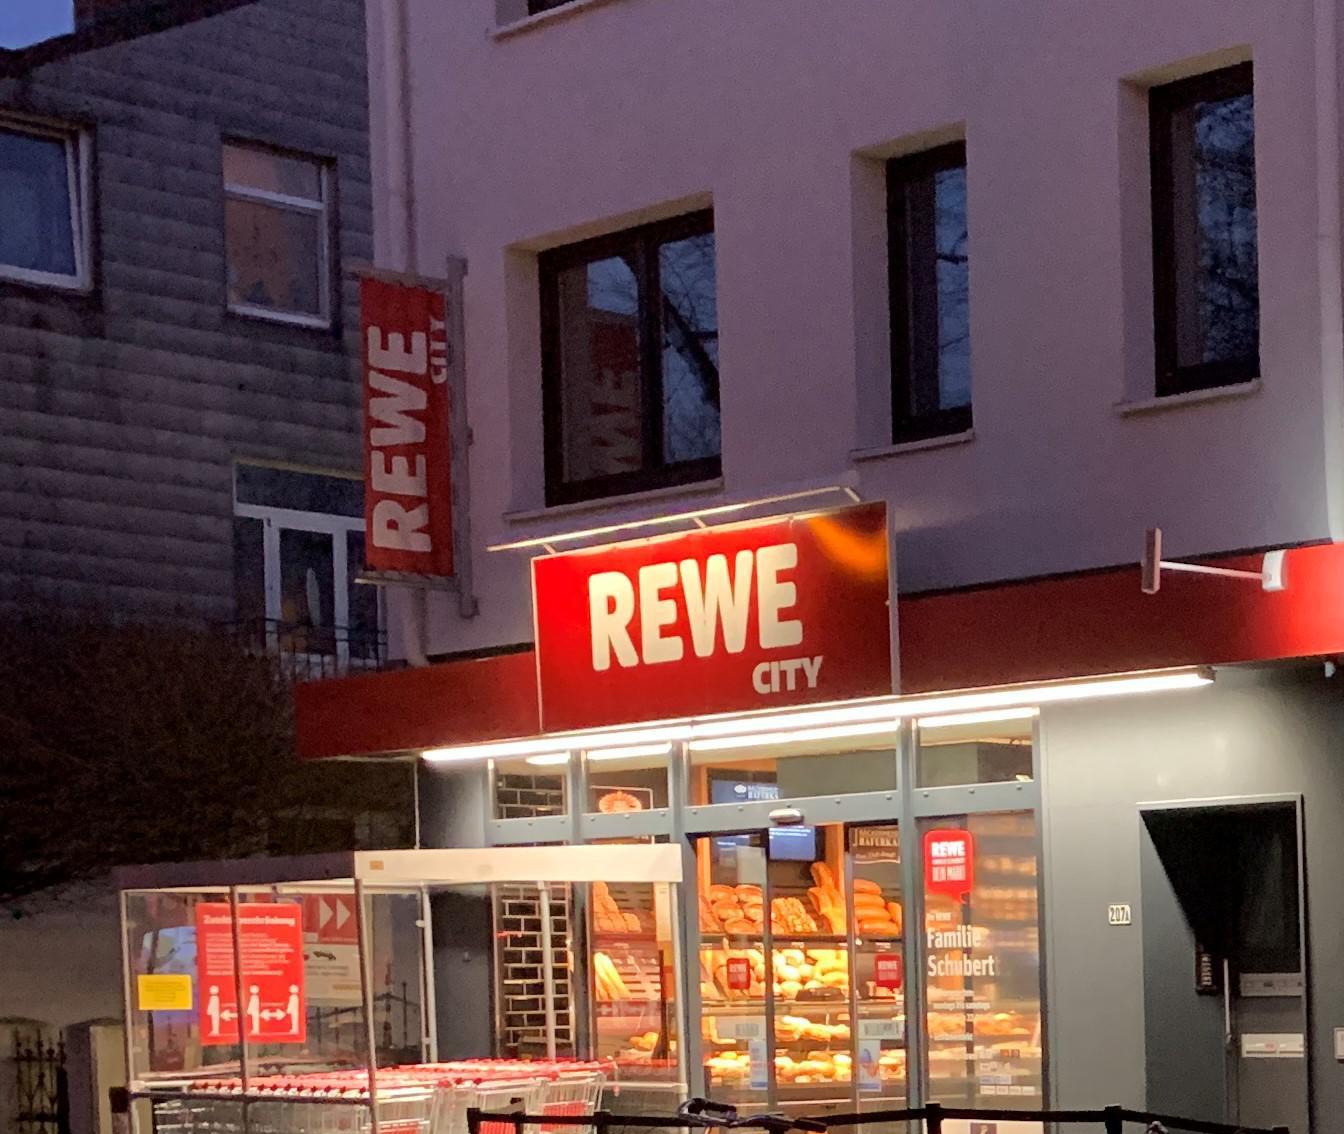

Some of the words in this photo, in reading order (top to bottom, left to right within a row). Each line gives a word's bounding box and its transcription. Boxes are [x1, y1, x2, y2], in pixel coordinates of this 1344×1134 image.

[430, 315, 448, 384] CITY
[368, 325, 432, 552] REWE
[589, 543, 804, 672] REWE
[752, 656, 824, 695] CITY
[931, 840, 966, 857] REWE
[927, 925, 982, 949] Familie
[927, 953, 996, 977] Schubert
